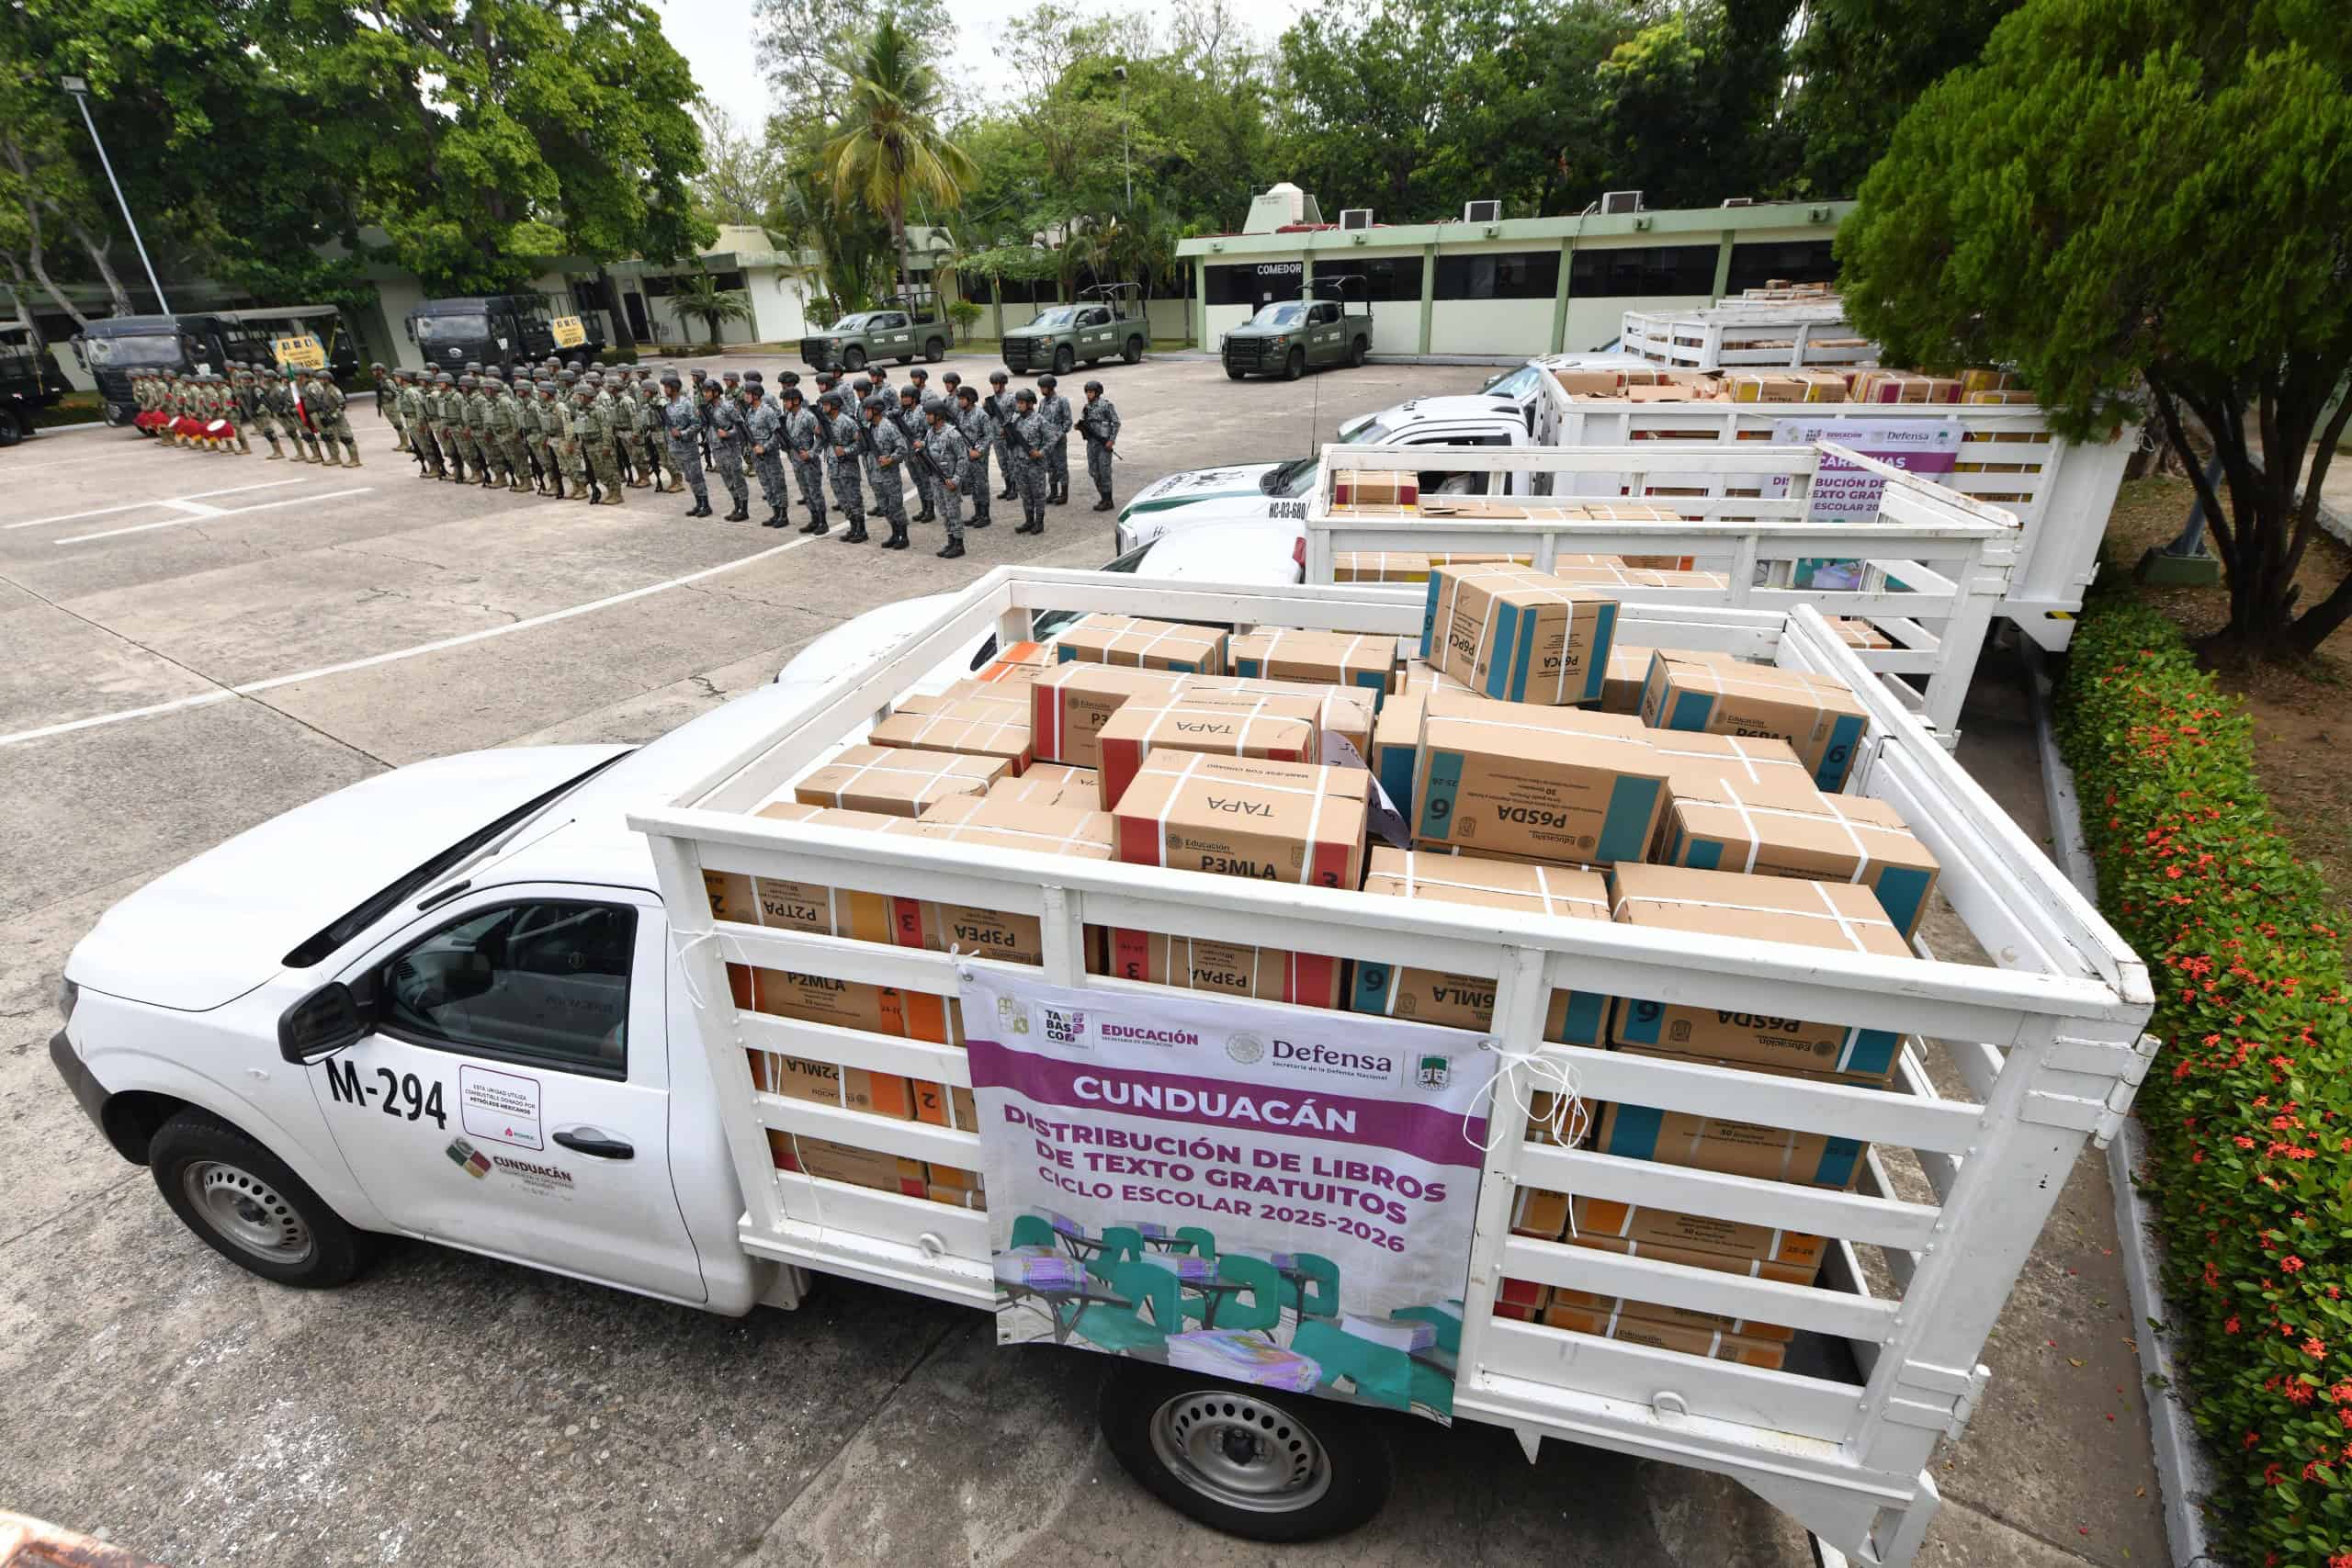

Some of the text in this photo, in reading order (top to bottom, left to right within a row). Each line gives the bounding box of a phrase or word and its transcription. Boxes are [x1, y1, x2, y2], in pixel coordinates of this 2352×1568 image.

[1258, 264, 1301, 275] COMEDOR
[1887, 431, 1929, 440] Defensa
[1812, 490, 1847, 500] EXTO
[1814, 502, 1864, 512] ESCOLAR
[1176, 721, 1234, 734] TAPA
[1828, 744, 1847, 763] 6
[1207, 796, 1275, 818] TAPA
[1430, 798, 1451, 820] 6
[1498, 805, 1567, 829] P6SDA
[1185, 838, 1230, 851] Educación
[1201, 855, 1277, 879] P3MLA
[763, 900, 817, 921] P2TPA
[901, 915, 915, 931] 3
[954, 925, 1016, 947] P3PEA
[1046, 1010, 1062, 1021] TA
[1046, 1020, 1071, 1032] BAS
[1102, 1023, 1199, 1045] EDUCACIÓN
[1272, 1039, 1392, 1073] Defensa
[325, 1057, 447, 1130] M-294
[922, 1092, 936, 1109] 2
[1072, 1074, 1358, 1134] CUNDUACÁN
[1003, 1104, 1447, 1203] DISTRIBUCIÓN DE LIBROS
[493, 1156, 572, 1181] CUNDUACÁN
[1035, 1140, 1408, 1225] DE TEXTO GRATUITOS
[1038, 1166, 1406, 1254] CICLO ESCOLAR 2025-2026
